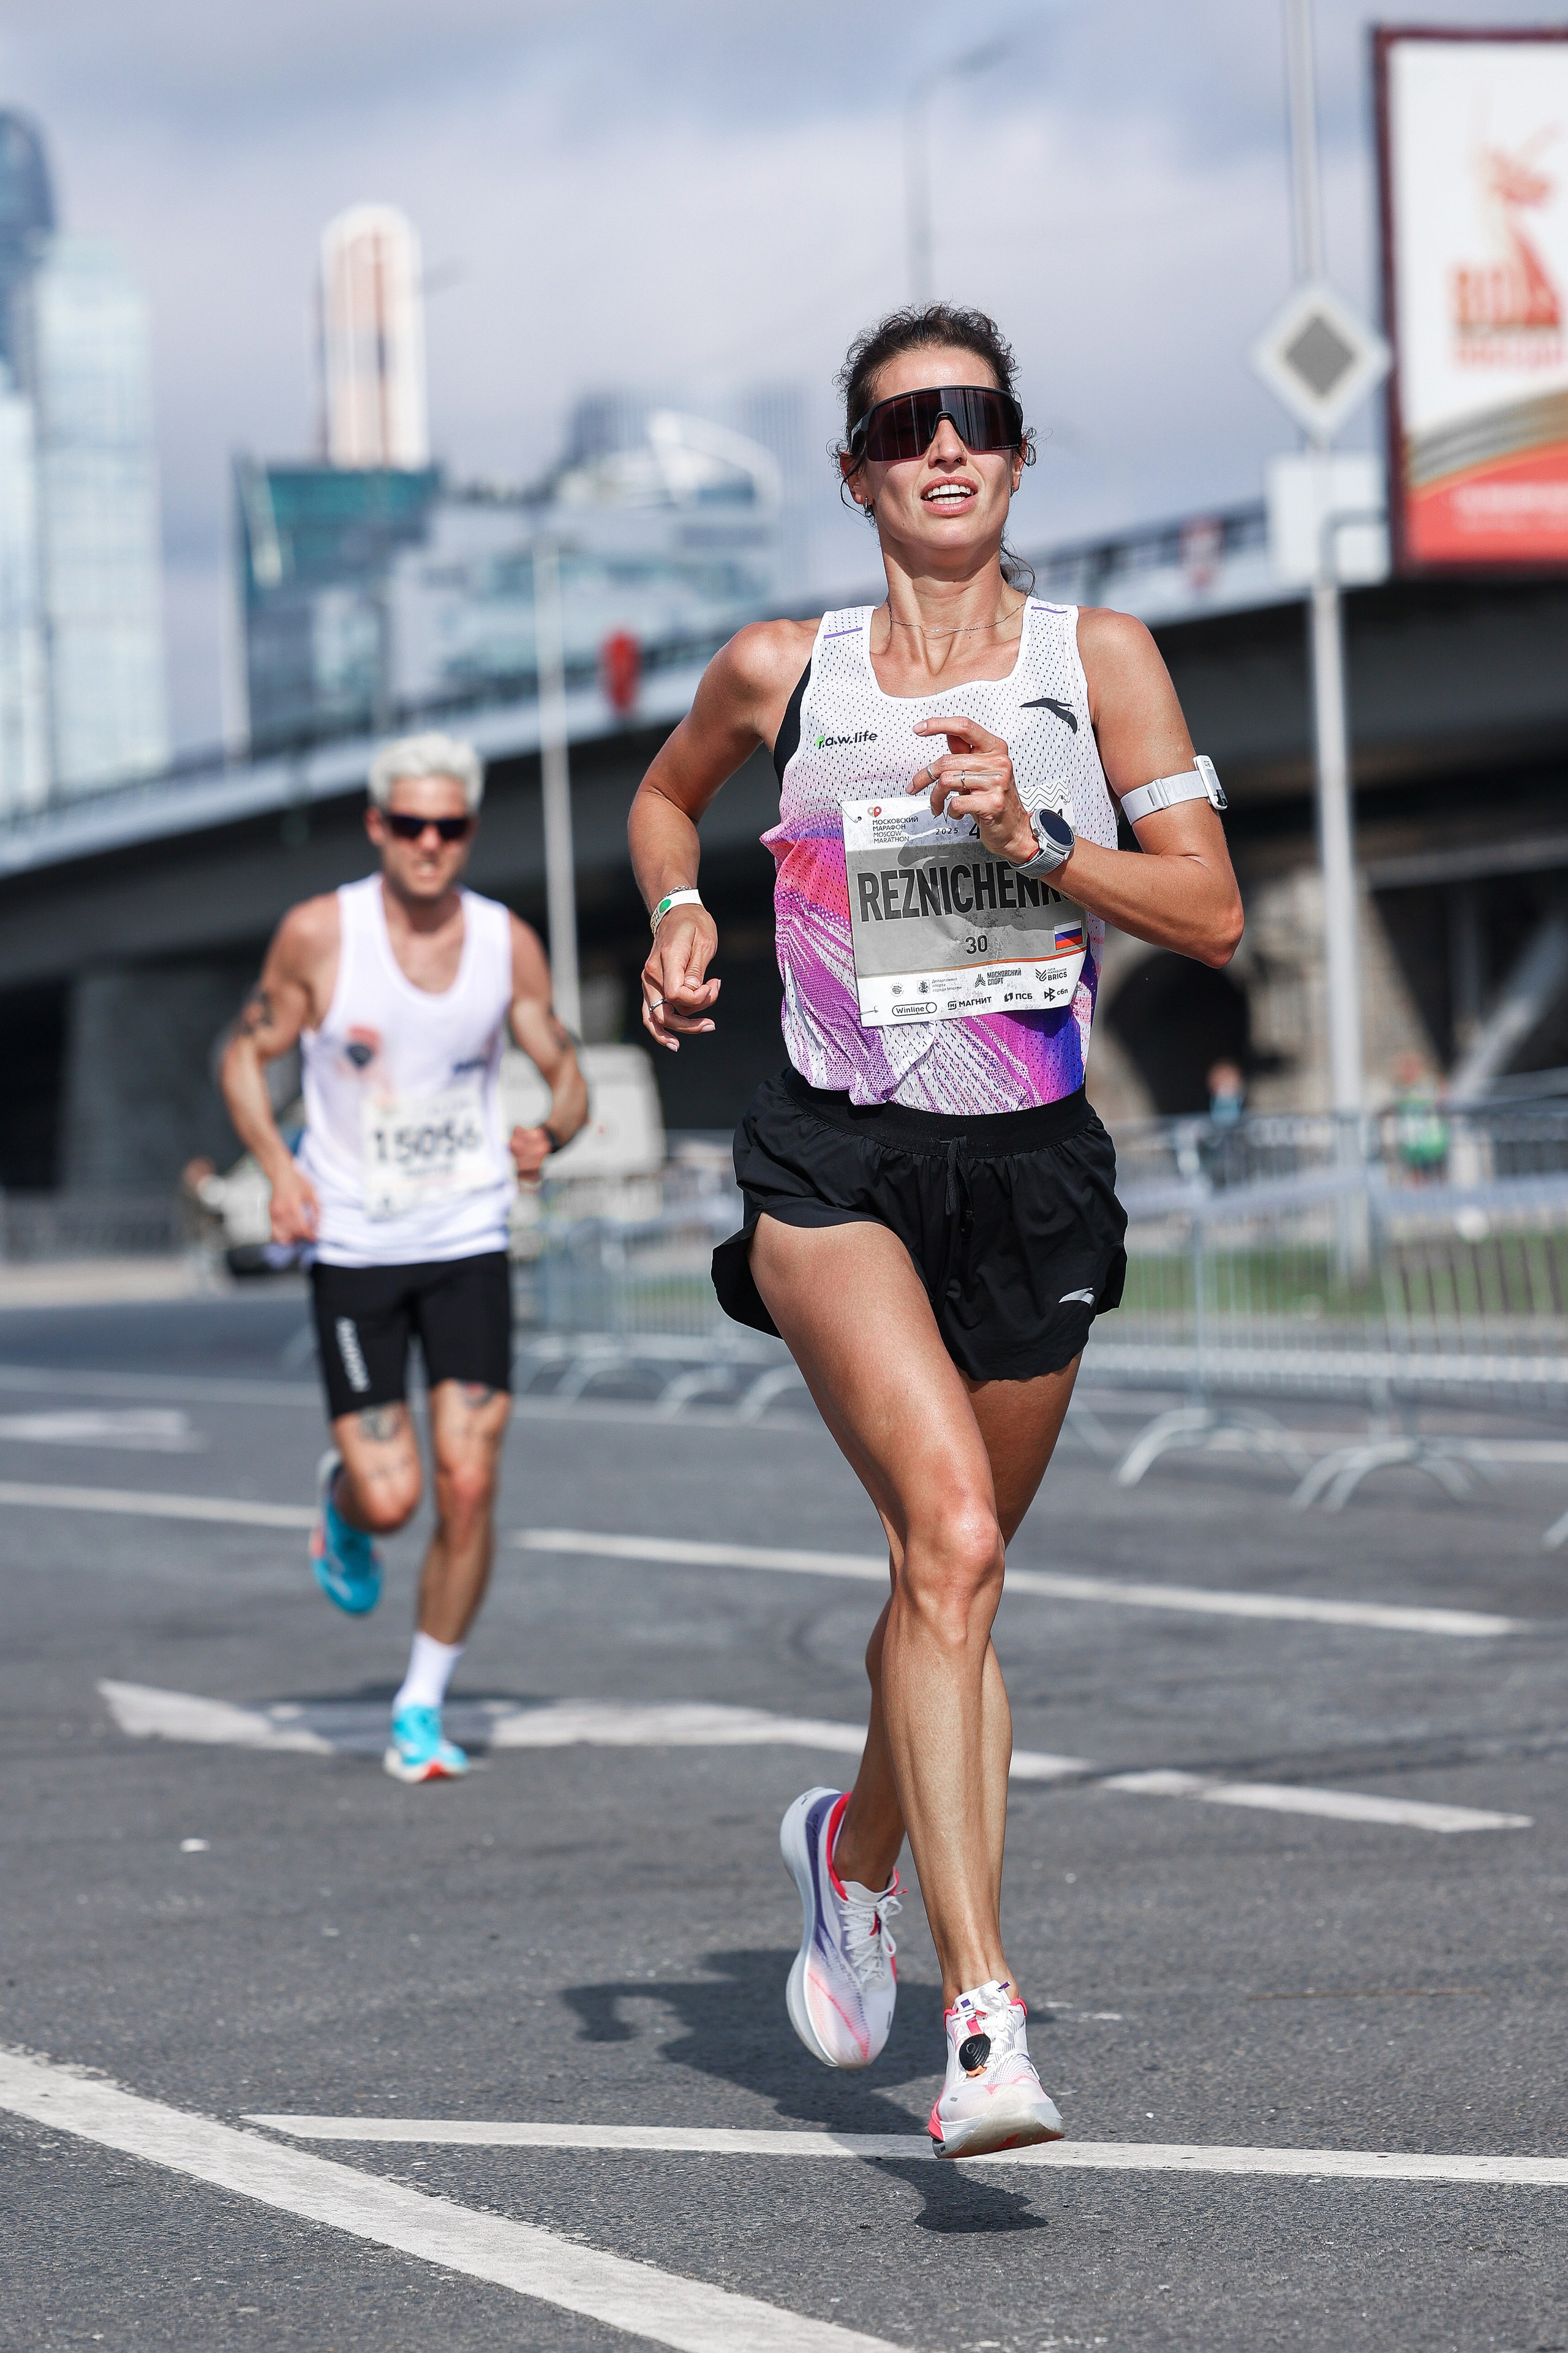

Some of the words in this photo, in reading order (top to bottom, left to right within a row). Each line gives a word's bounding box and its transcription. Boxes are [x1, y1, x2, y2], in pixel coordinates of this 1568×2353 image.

[872, 815, 919, 825] МОСКОВСКИЙ
[935, 827, 959, 836] 2025
[873, 836, 910, 844] MARATHON
[857, 861, 1069, 923] REZNICHEN
[965, 935, 989, 955] 30
[987, 968, 1022, 978] МОСКОВСКИЙ
[1048, 972, 1068, 981] BRICS
[959, 996, 992, 1008] МАГНИТ
